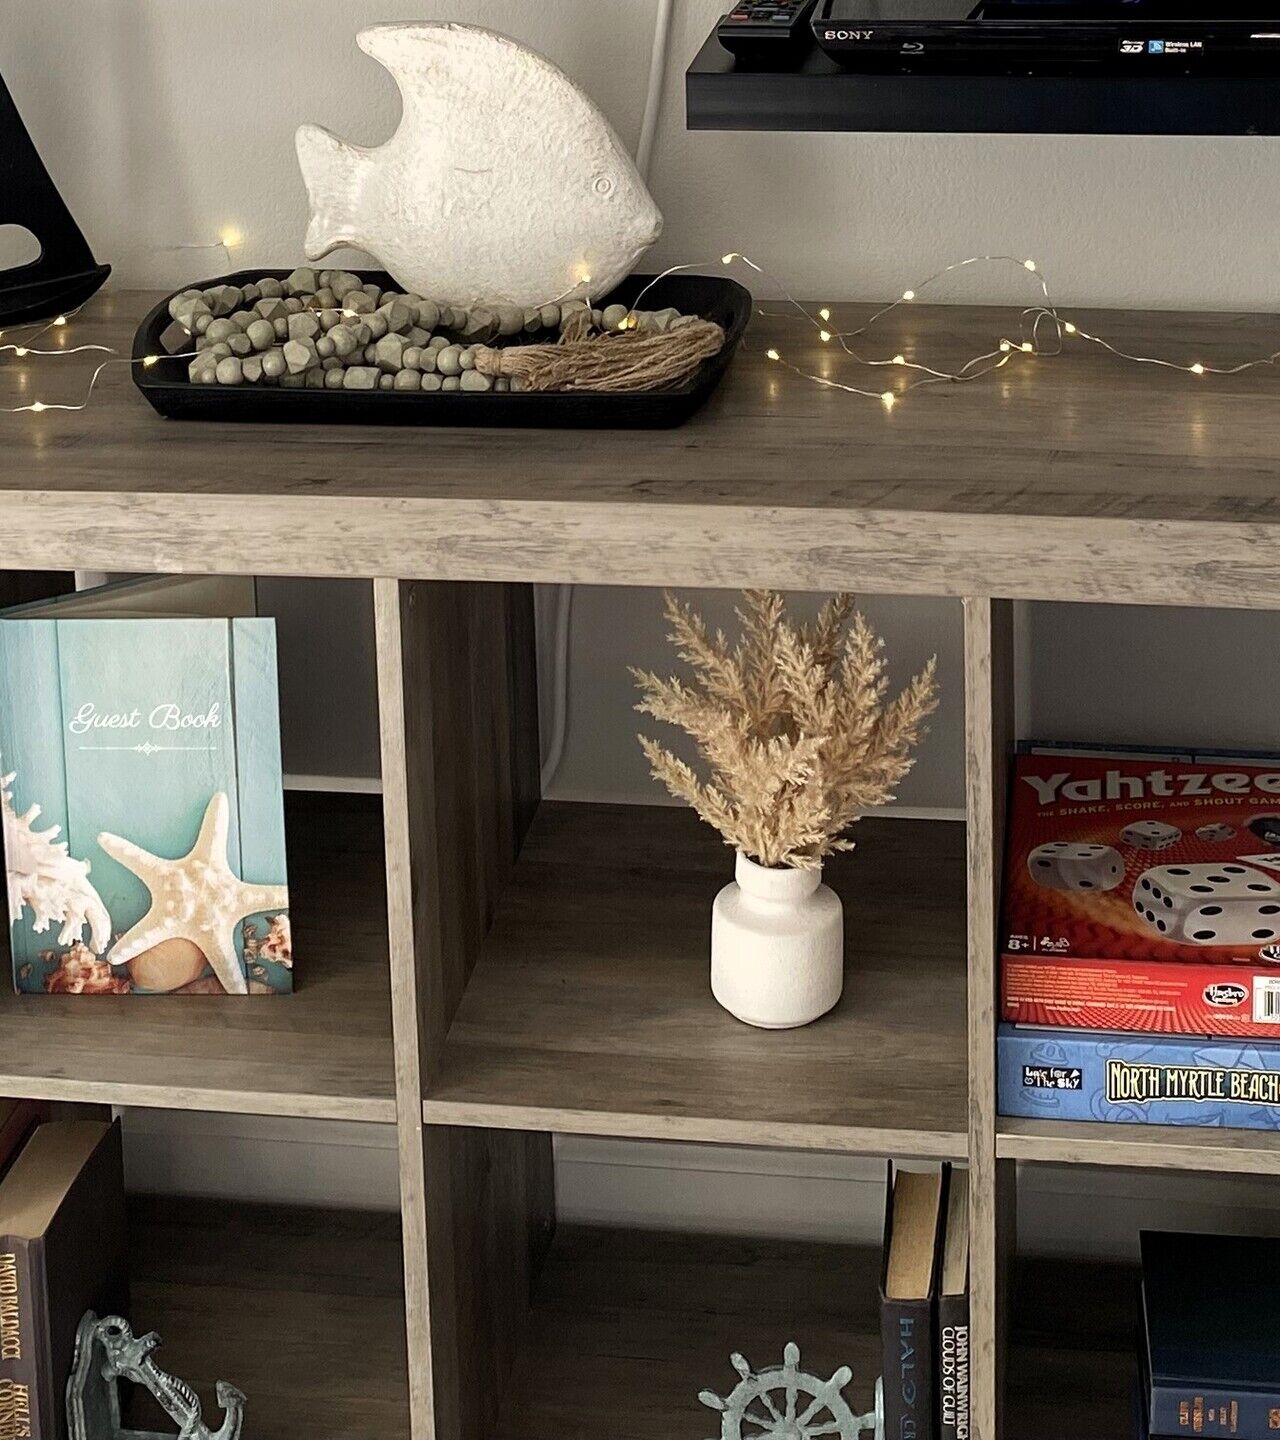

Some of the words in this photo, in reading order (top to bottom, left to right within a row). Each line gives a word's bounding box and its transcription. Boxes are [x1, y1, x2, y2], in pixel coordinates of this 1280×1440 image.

[824, 30, 873, 41] SONY
[69, 703, 141, 734] Guest
[149, 702, 221, 731] Book
[1060, 806, 1110, 815] SHAKE,
[1116, 801, 1164, 809] SCORE,
[1194, 798, 1245, 806] SHOUT
[1008, 940, 1029, 949] 8+
[1110, 1062, 1160, 1098] NORTH
[1166, 1067, 1225, 1098] MYRTLE
[1231, 1070, 1279, 1101] BEACH
[0, 1295, 21, 1360] BALDACCI
[942, 1327, 955, 1375] CLOUDS
[955, 1326, 968, 1362] JOHN
[900, 1318, 916, 1405] HALO
[943, 1376, 955, 1394] OF
[943, 1395, 956, 1426] GUILT
